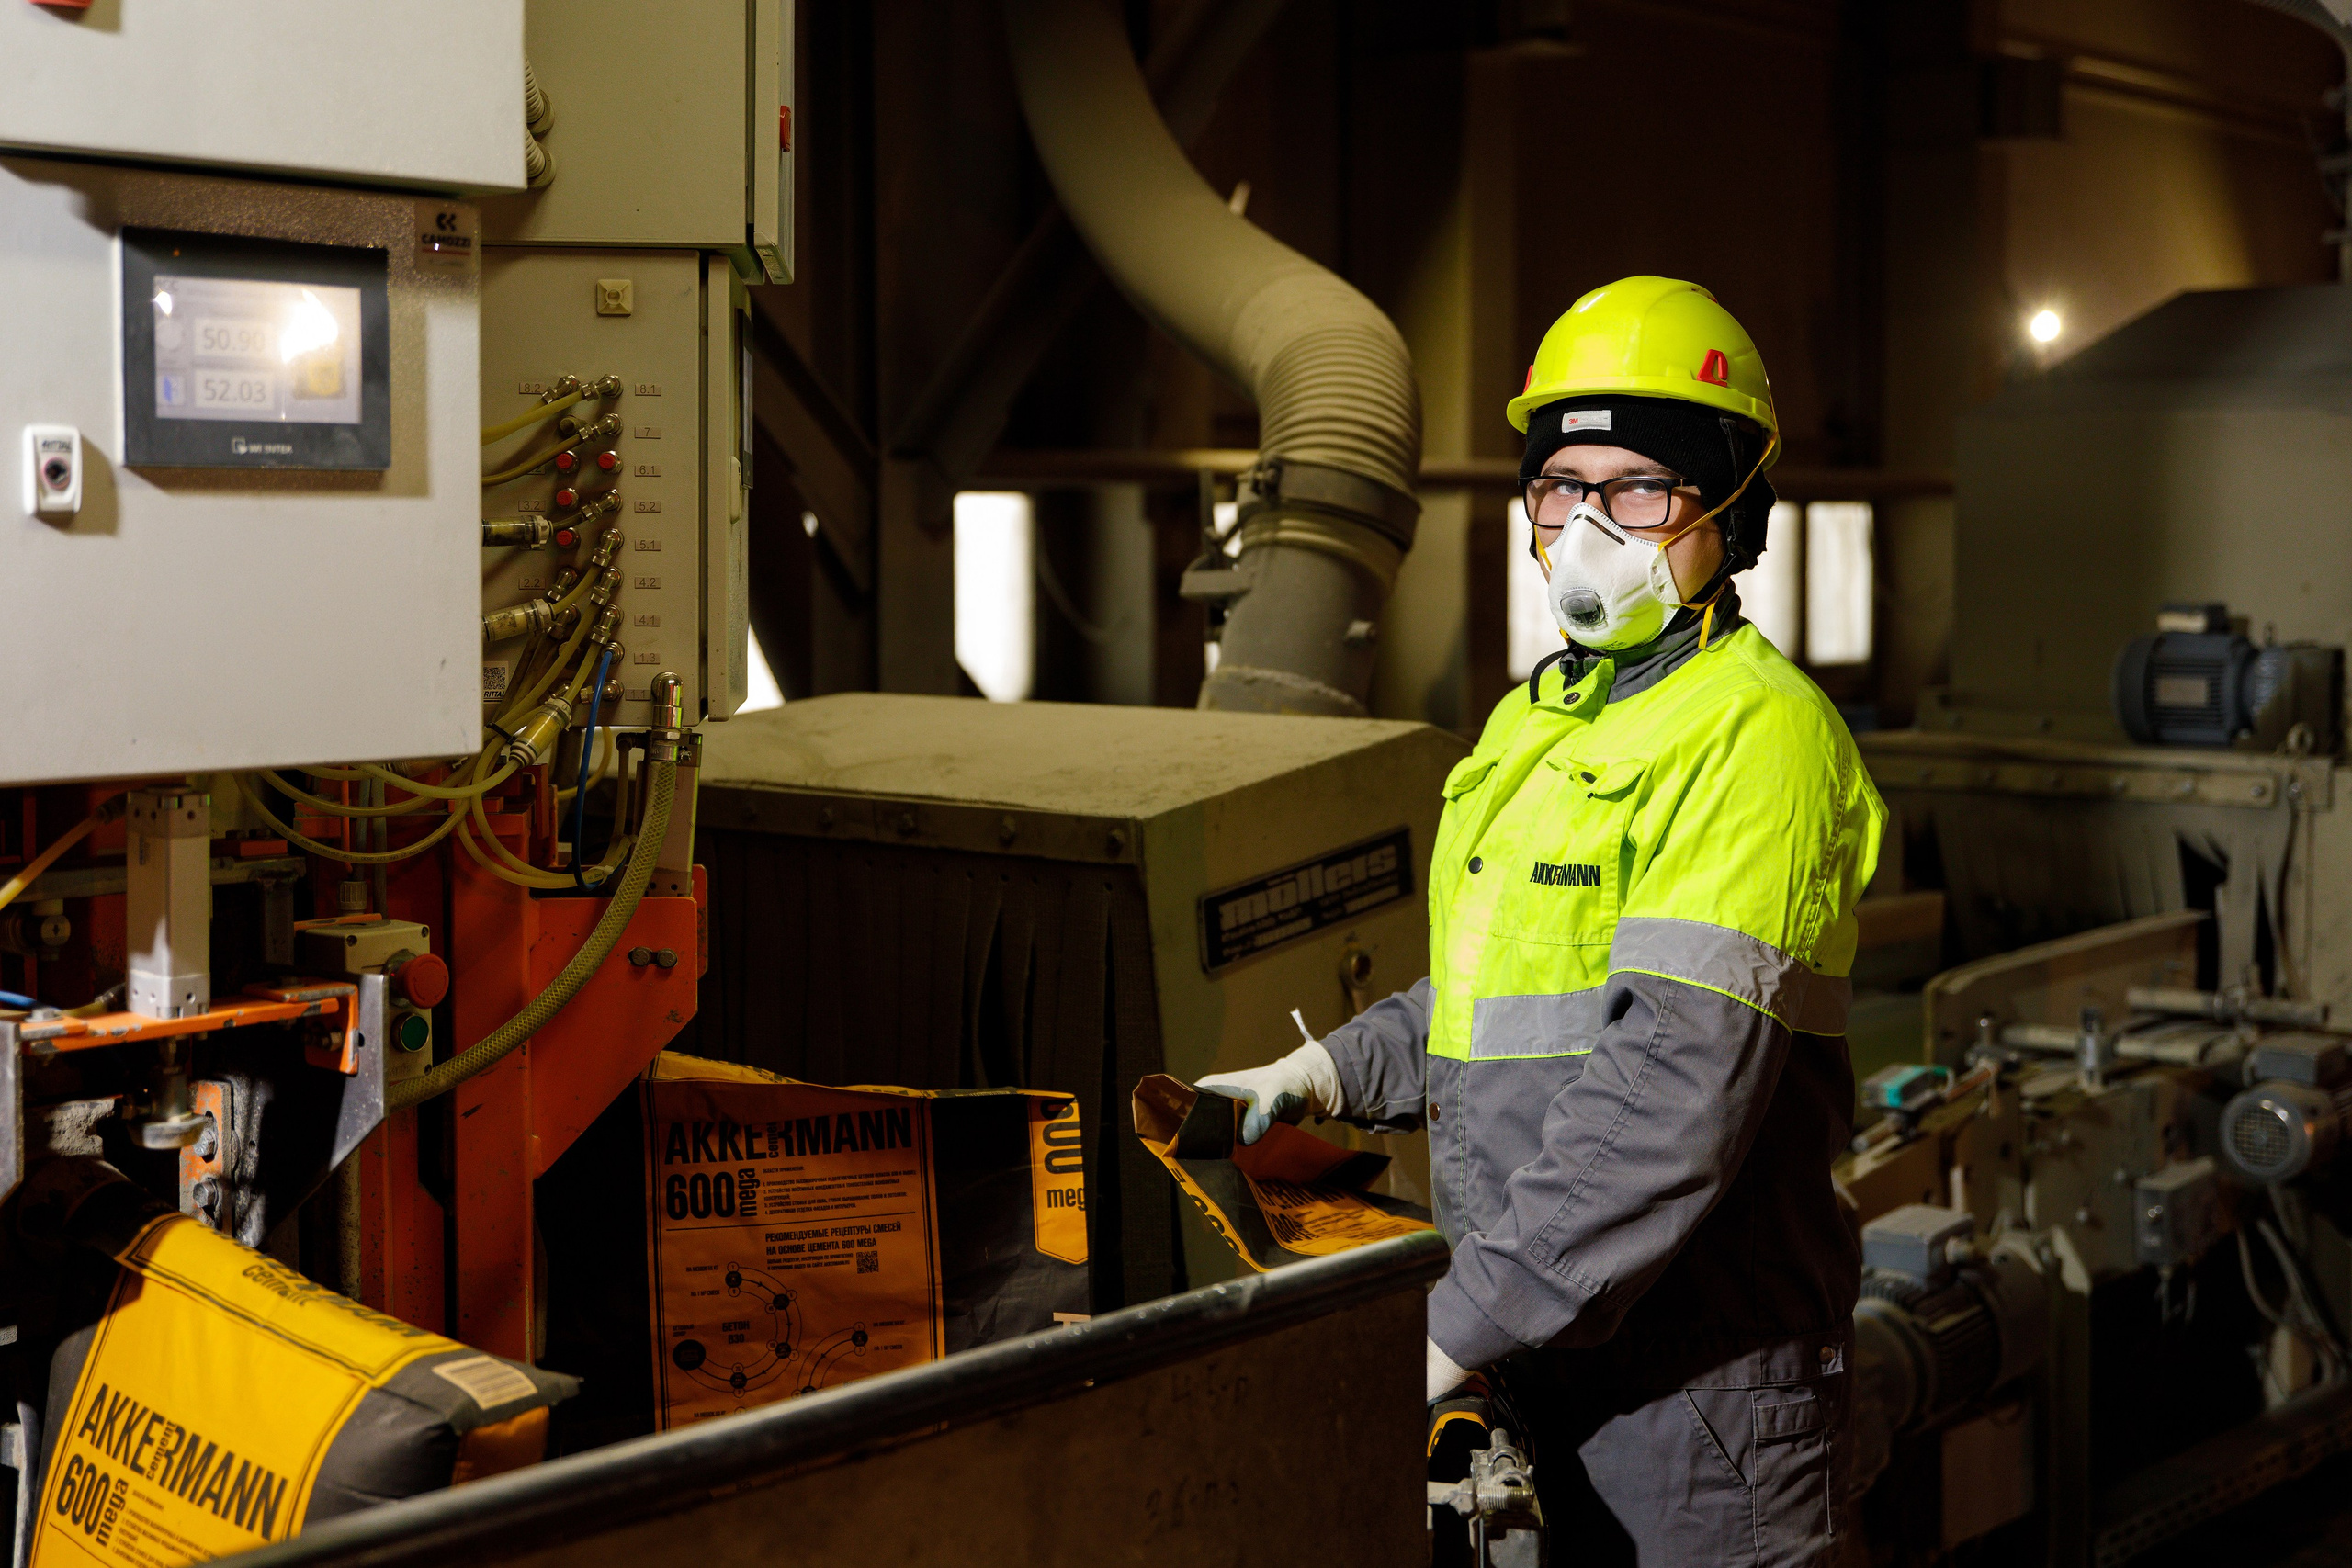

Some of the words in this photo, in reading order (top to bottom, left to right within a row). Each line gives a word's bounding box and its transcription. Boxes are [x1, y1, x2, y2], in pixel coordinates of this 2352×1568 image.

[202, 327, 266, 352] 50.90
[203, 378, 266, 402] 52.03
[524, 383, 541, 392] 8.2
[639, 384, 656, 394] 8.1
[644, 427, 651, 437] 7
[639, 465, 656, 475] 6.1
[523, 501, 540, 511] 3.2
[639, 502, 656, 512] 5.2
[639, 540, 656, 549] 5.1
[524, 578, 541, 588] 2.2
[639, 578, 656, 587] 4.2
[639, 615, 656, 626] 4.1
[639, 653, 656, 662] 1.3
[630, 690, 647, 699] 1.1
[1530, 862, 1600, 886] AKKERMANN
[664, 1107, 912, 1165] AKKERMANN
[666, 1171, 735, 1221] 600
[738, 1168, 760, 1217] mega
[765, 1228, 829, 1242] РЕКОМЕНДУЕМЫЕ
[831, 1224, 871, 1238] РЕЦЕПТУРЫ
[873, 1221, 901, 1234] СМЕСЕЙ
[766, 1246, 776, 1255] НА
[778, 1244, 806, 1254] ОСНОВЕ
[808, 1240, 840, 1253] ЦЕМЕНТА
[842, 1239, 855, 1249] 600
[722, 1320, 750, 1332] БЕТОН
[145, 1420, 179, 1481] cement
[77, 1382, 288, 1541] AKKERMANN
[56, 1453, 111, 1535] 600
[96, 1477, 130, 1548] mega
